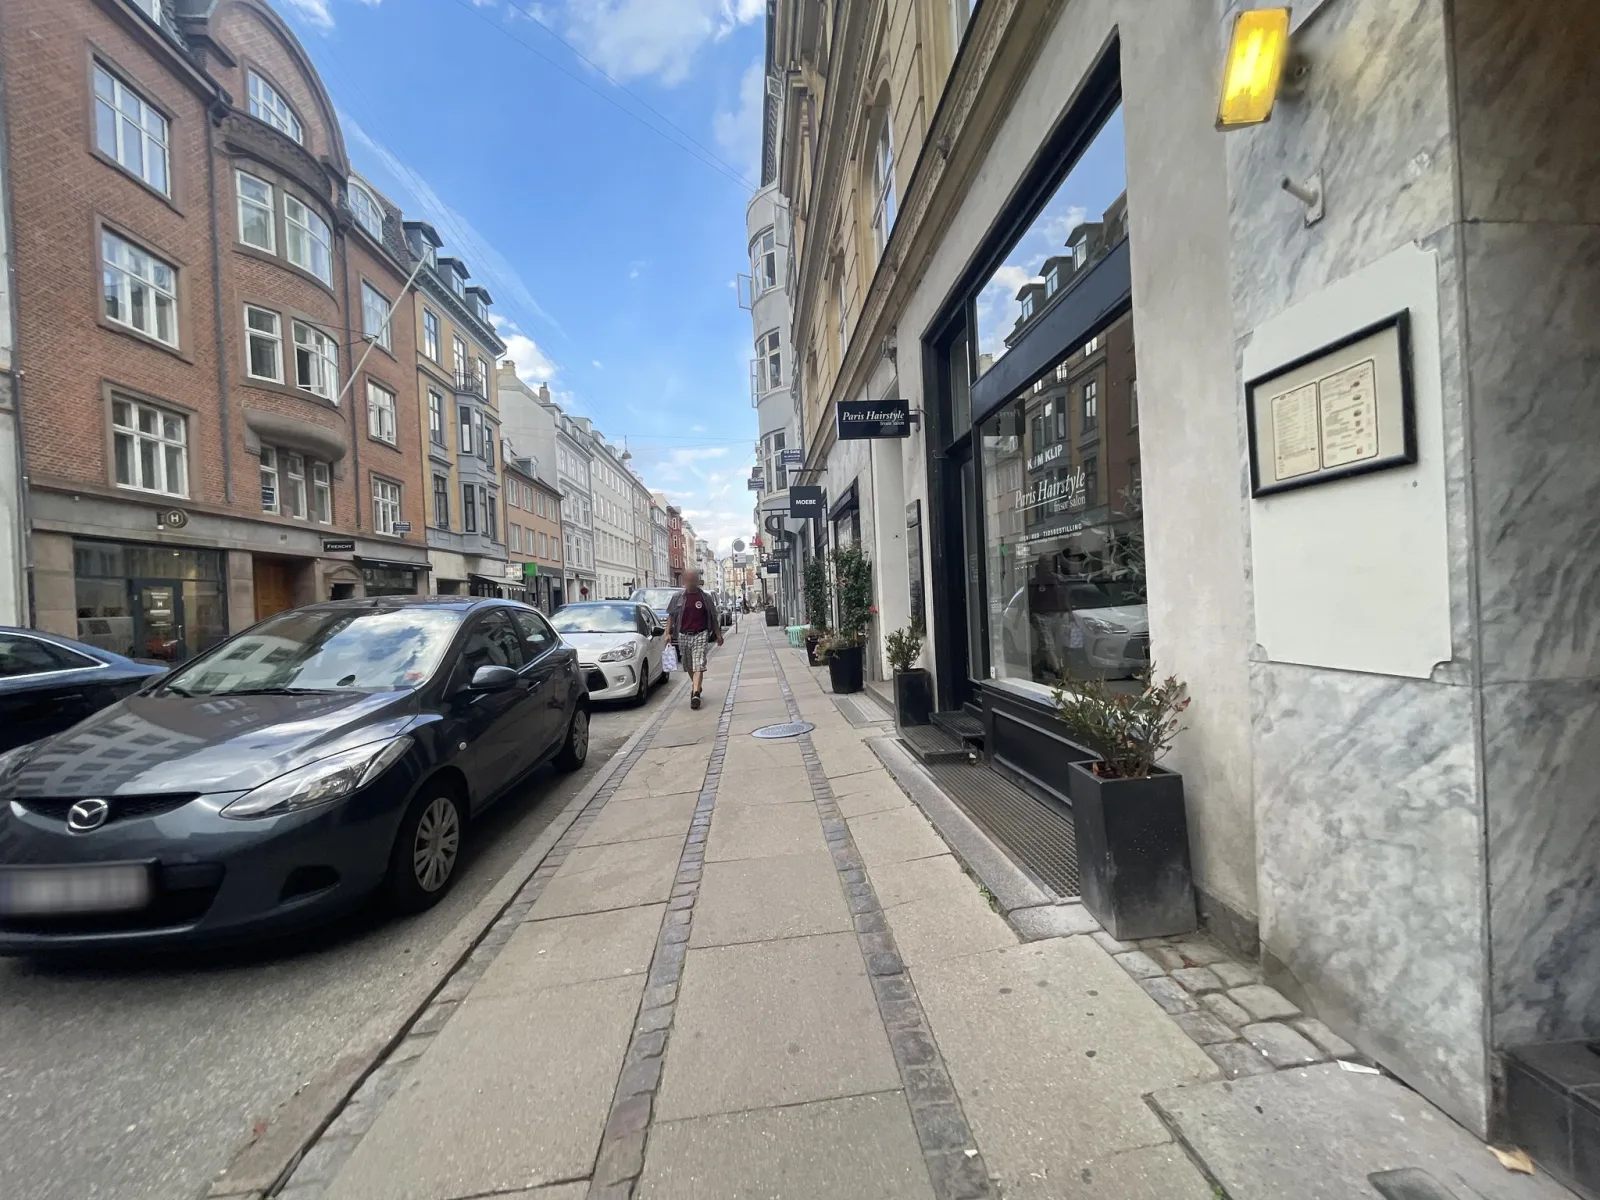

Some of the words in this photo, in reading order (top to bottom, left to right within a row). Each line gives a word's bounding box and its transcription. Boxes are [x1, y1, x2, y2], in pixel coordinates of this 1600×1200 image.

[842, 412, 864, 421] Paris
[866, 410, 905, 422] Hairstyle
[1045, 444, 1063, 462] KLIP
[1015, 487, 1036, 509] Paris
[1037, 466, 1086, 499] Hairstyle
[1070, 495, 1086, 508] salon
[170, 514, 179, 523] H
